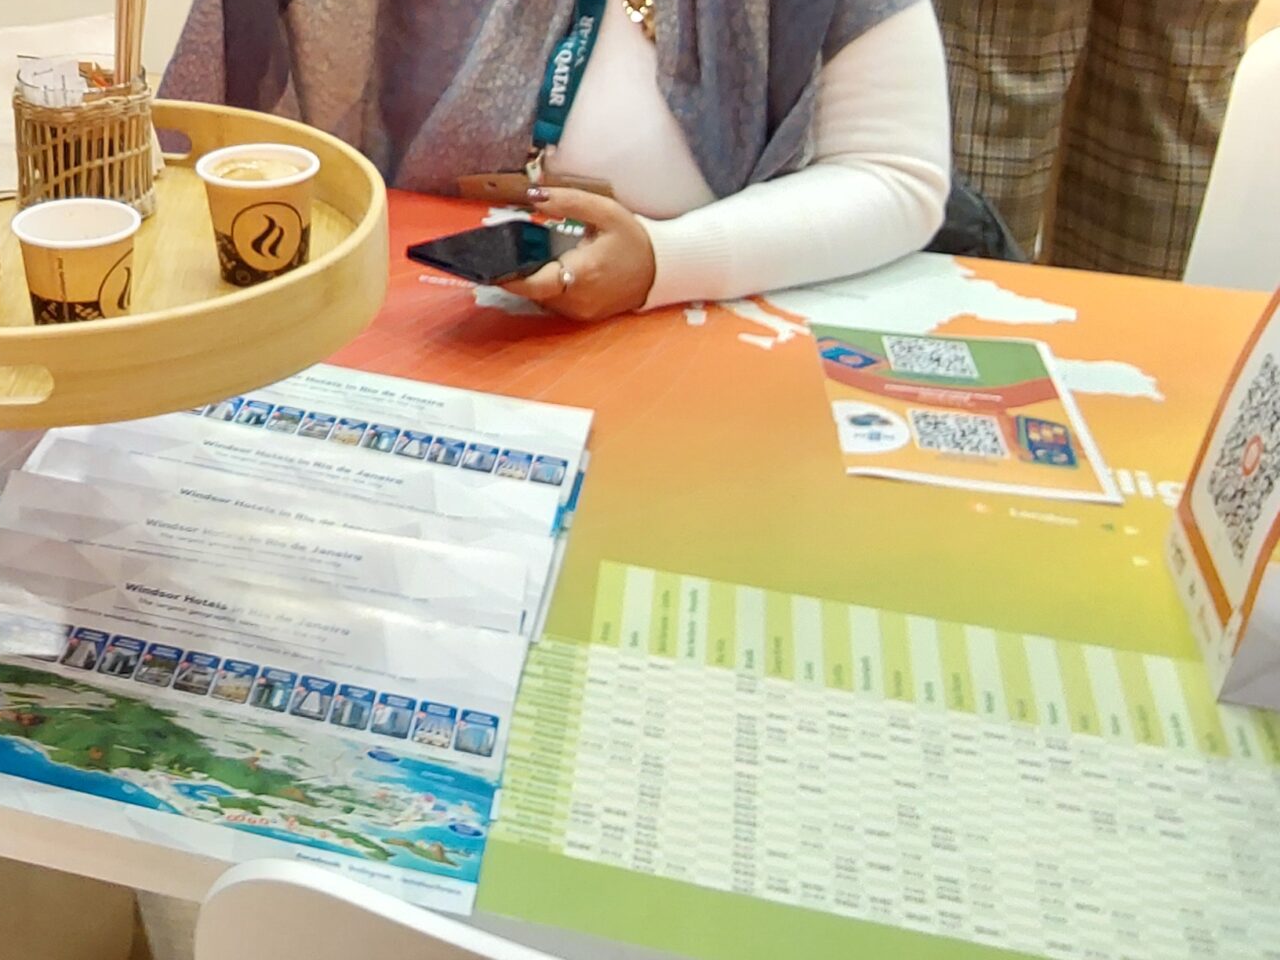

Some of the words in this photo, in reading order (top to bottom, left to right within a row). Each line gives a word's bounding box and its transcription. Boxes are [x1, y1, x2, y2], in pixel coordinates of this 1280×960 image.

[548, 48, 573, 107] QATAR
[179, 487, 231, 504] Windsor
[145, 518, 200, 536] Windsor
[125, 583, 181, 601] Windsor
[183, 594, 227, 611] Hotels
